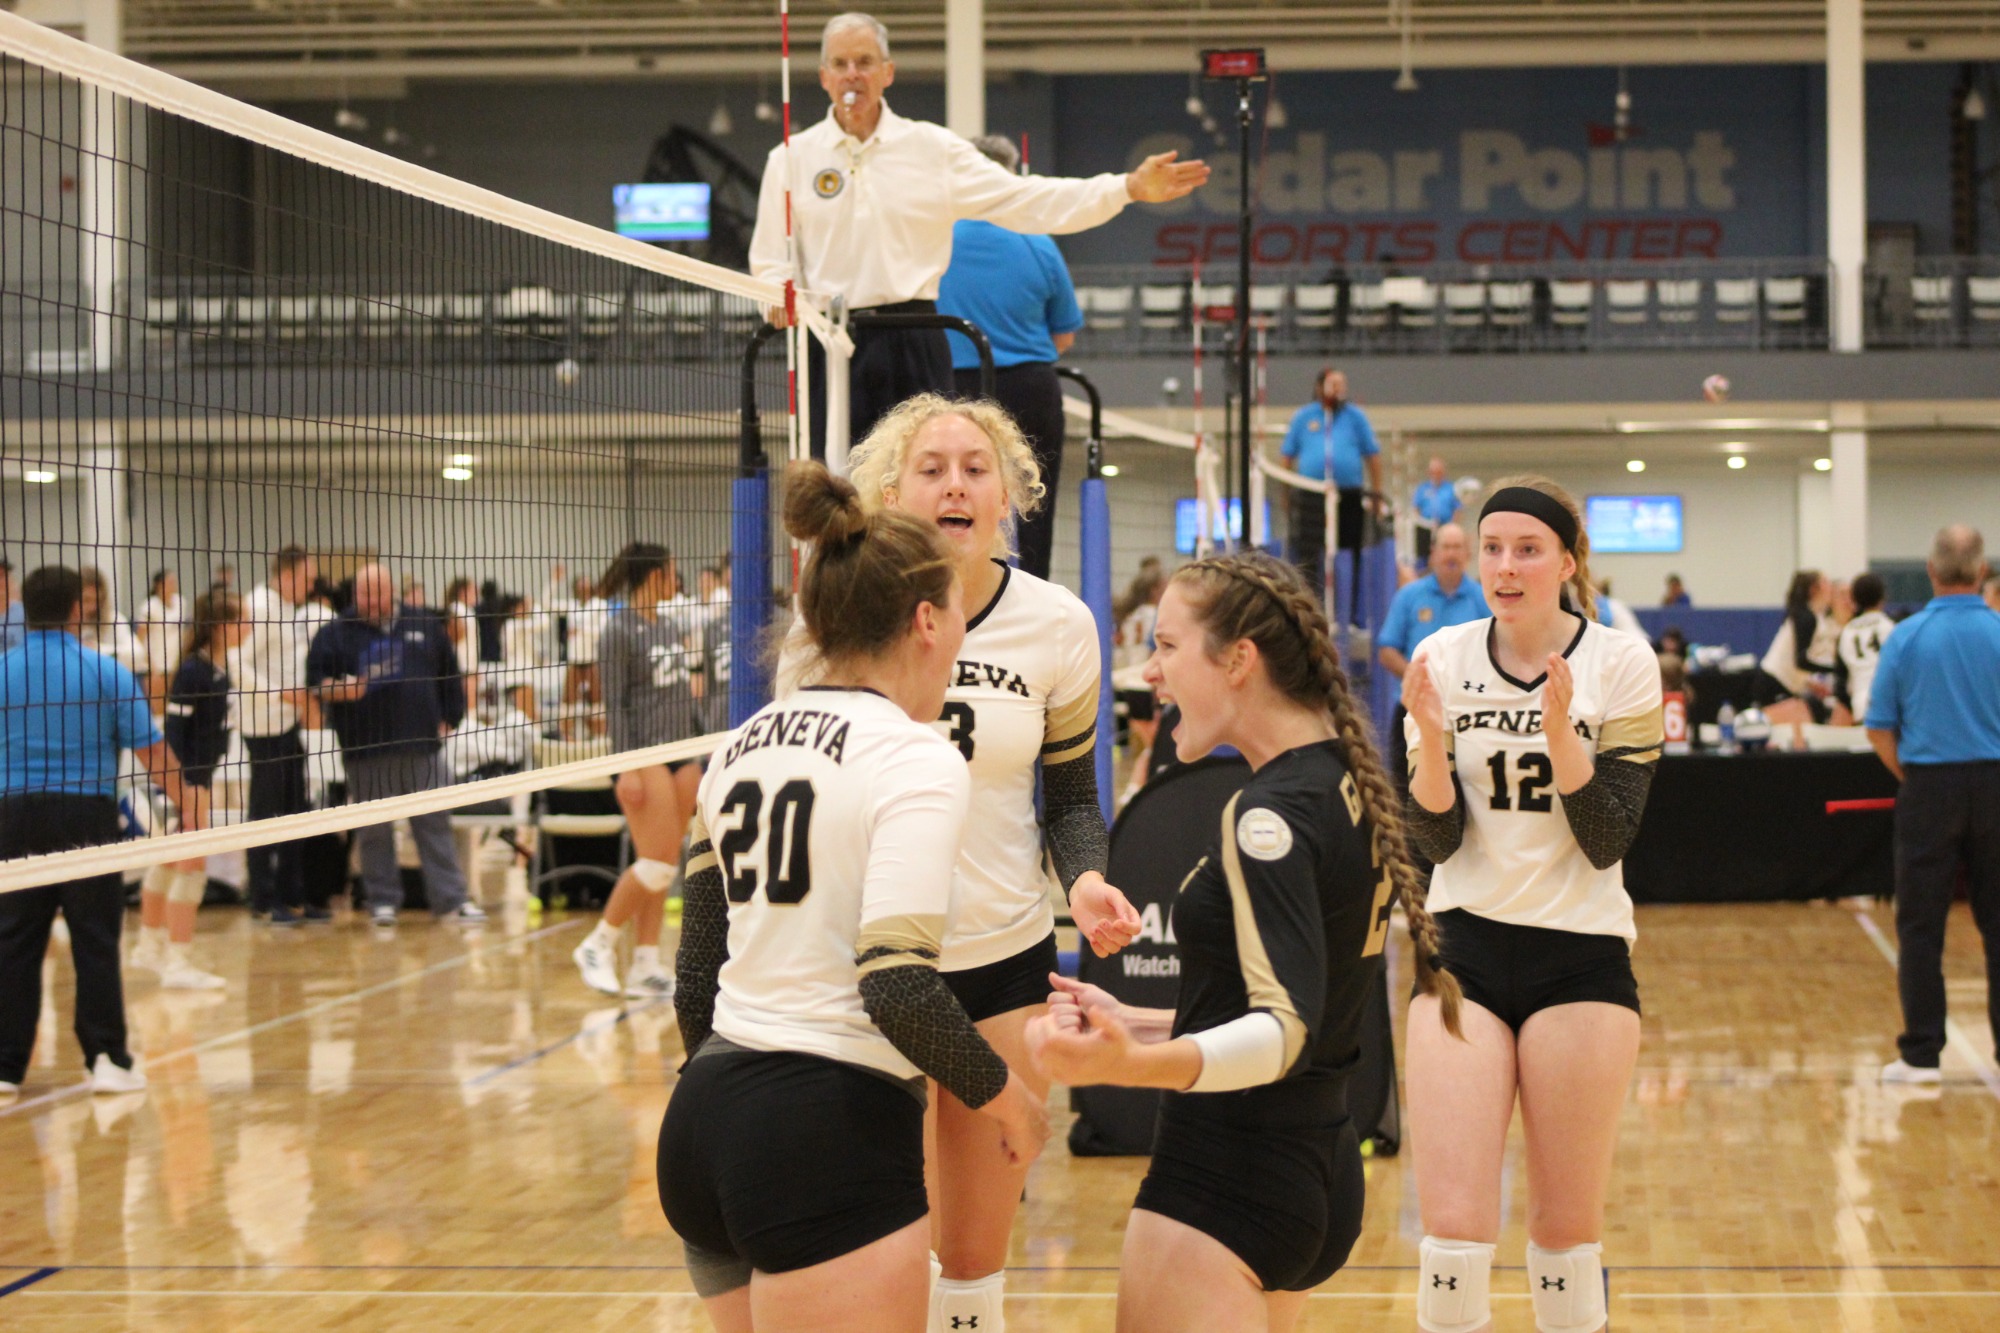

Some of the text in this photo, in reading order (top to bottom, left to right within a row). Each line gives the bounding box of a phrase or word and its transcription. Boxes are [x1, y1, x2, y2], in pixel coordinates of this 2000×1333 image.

[1127, 128, 1736, 213] Cedar Point
[1153, 218, 1724, 265] SPORTS CENTER
[1853, 630, 1882, 659] 14
[947, 660, 1030, 697] EVA
[1456, 710, 1593, 740] GENEA
[1664, 700, 1685, 739] 6
[1487, 750, 1554, 814] 12
[719, 777, 817, 906] 20
